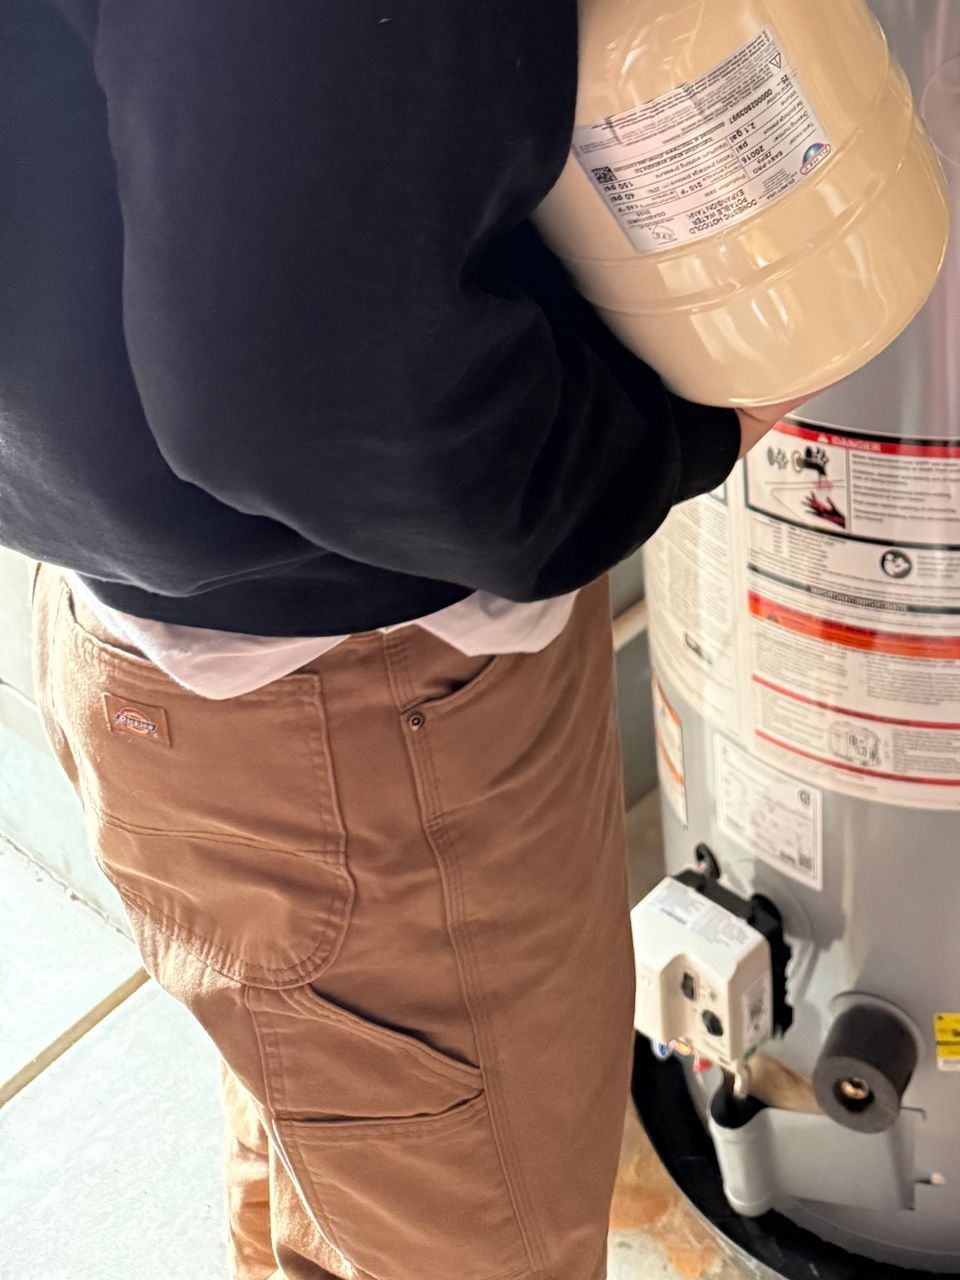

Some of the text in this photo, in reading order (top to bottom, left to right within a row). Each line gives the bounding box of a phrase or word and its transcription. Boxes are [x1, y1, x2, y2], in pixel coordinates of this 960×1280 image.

[728, 128, 744, 142] gal
[743, 122, 756, 134] 2.1
[735, 140, 749, 153] psi
[705, 188, 744, 211] EXPANSION
[686, 208, 706, 219] TANK
[691, 196, 748, 225] POTABLE WATER
[723, 198, 757, 220] DOMESTIC
[831, 435, 882, 452] DANGER
[119, 715, 154, 730] Dickies
